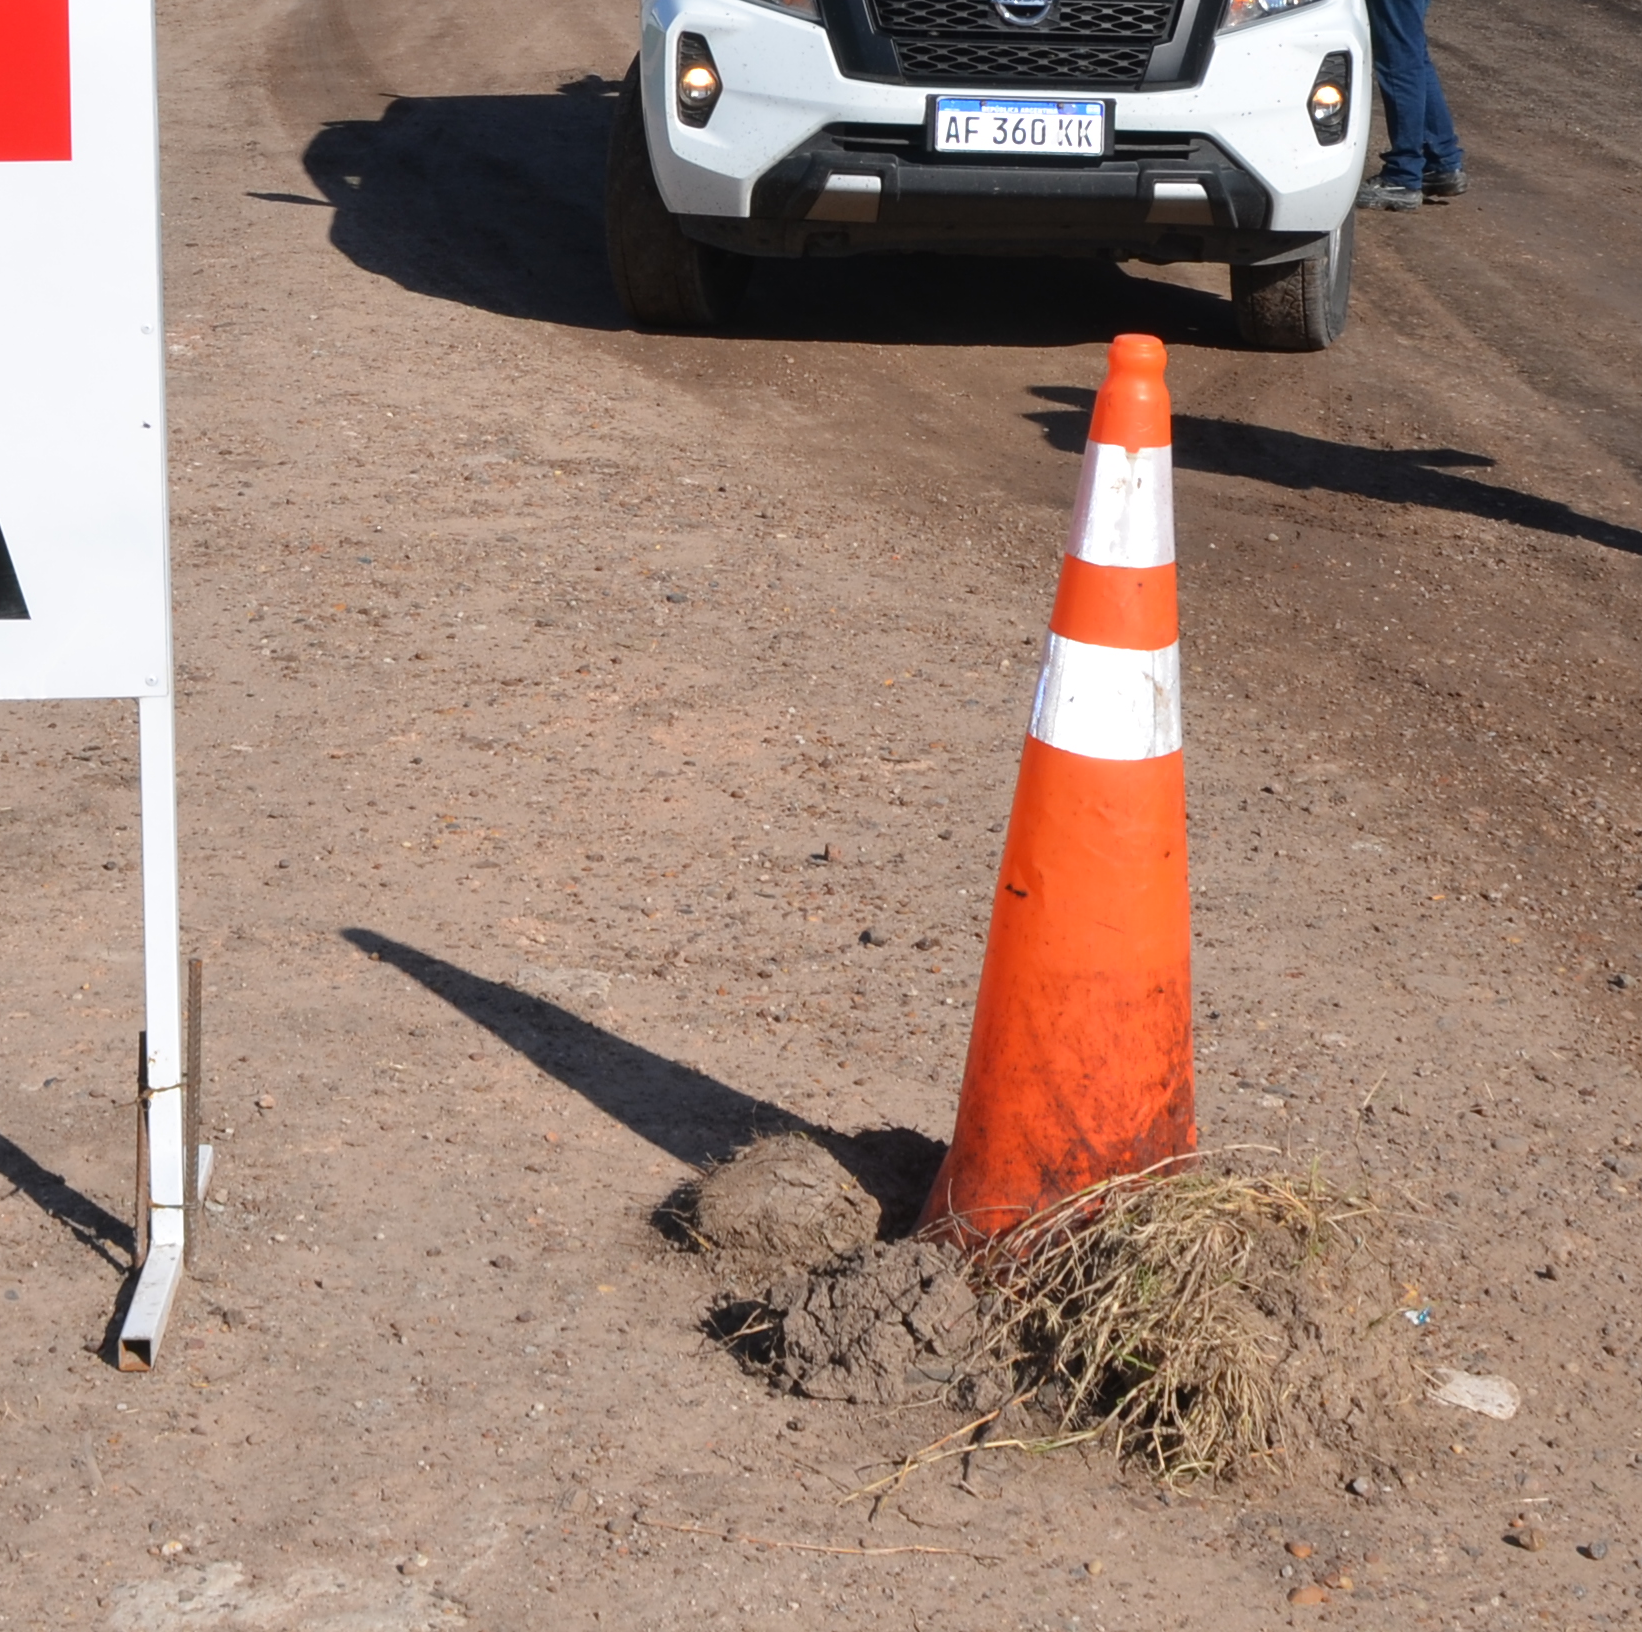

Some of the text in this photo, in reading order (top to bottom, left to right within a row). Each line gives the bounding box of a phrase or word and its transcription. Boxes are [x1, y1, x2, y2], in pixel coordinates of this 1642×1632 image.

[945, 116, 1093, 148] AF 360 KK
